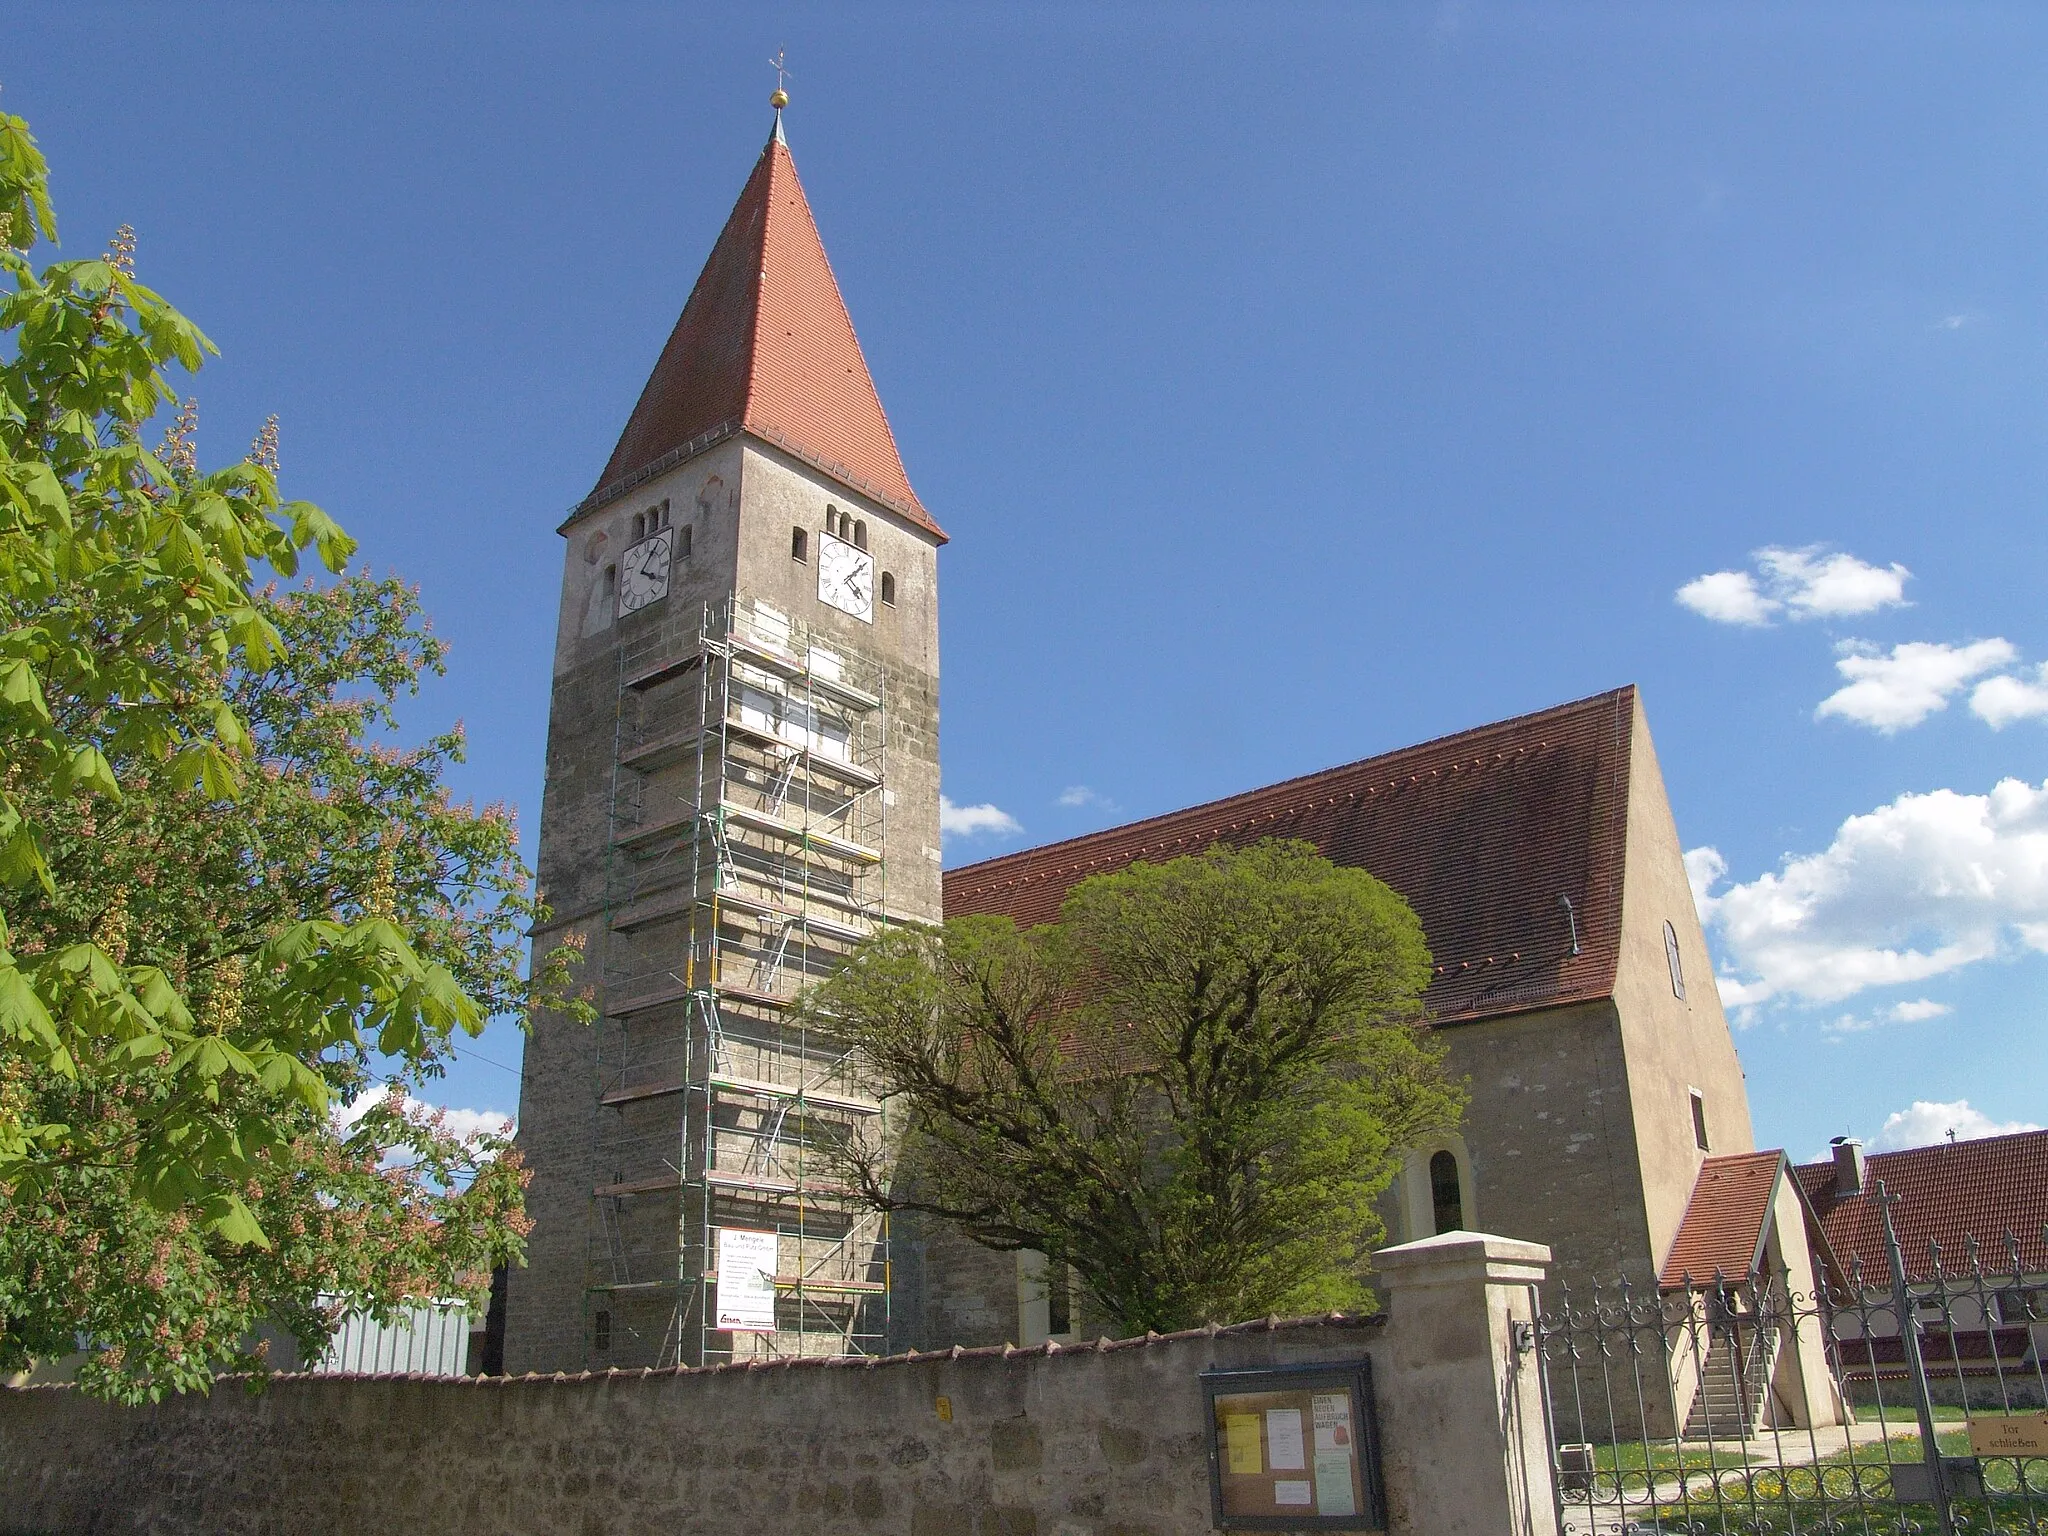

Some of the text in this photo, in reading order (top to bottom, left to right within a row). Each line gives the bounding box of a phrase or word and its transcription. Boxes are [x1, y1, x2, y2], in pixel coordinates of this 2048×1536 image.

[1314, 1396, 1332, 1405] EINEN
[1314, 1404, 1335, 1412] NEUEN
[1315, 1412, 1349, 1421] AUFBRUCH
[1315, 1420, 1338, 1429] WAGEN
[2000, 1424, 2019, 1434] Tor
[1989, 1437, 2038, 1448] schließen
